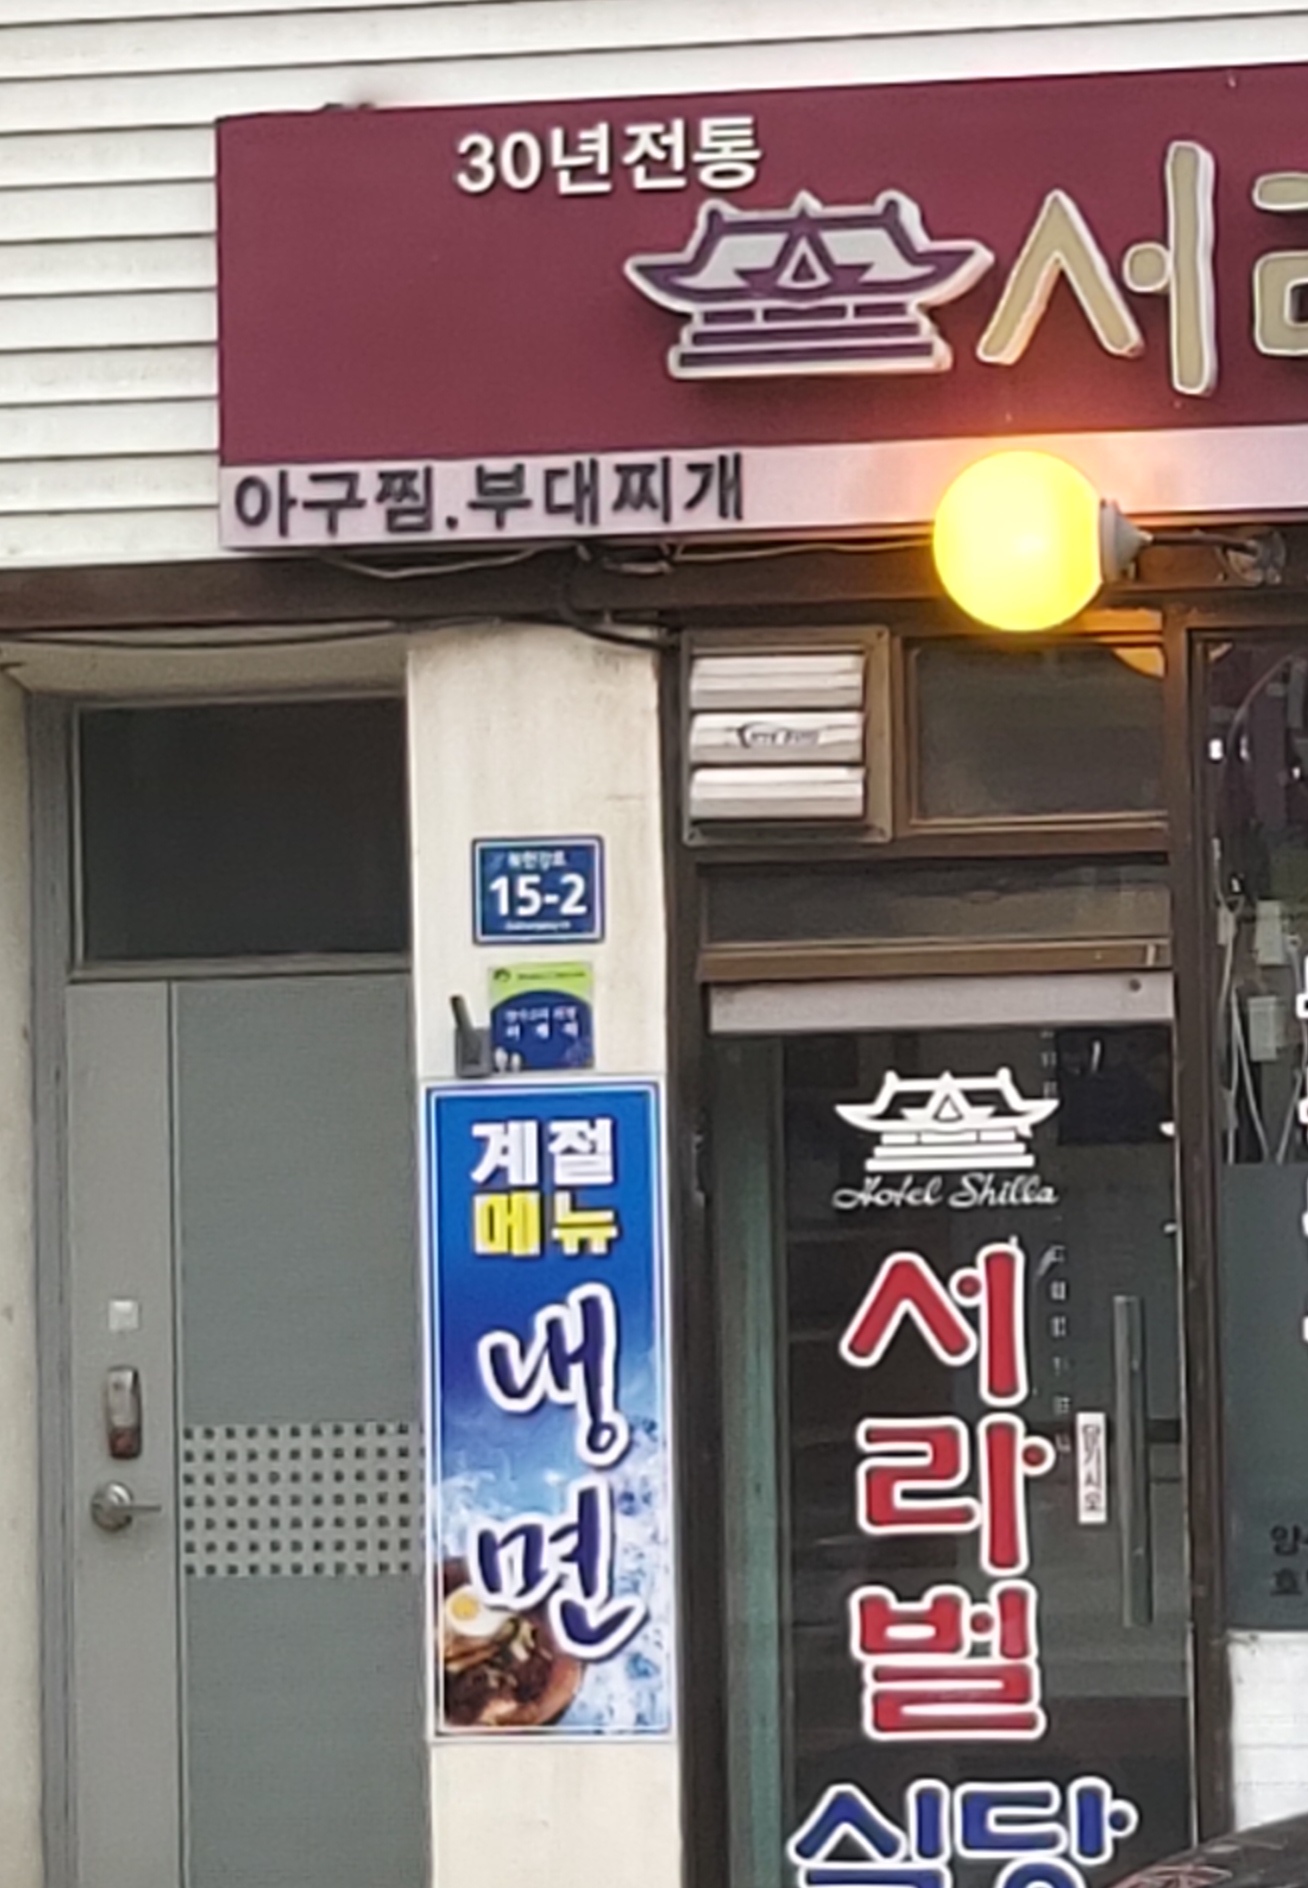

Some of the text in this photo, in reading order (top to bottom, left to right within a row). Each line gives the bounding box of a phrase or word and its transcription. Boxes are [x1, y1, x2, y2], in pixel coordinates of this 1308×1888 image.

[455, 114, 762, 196] 30년전통
[489, 873, 588, 917] 15-2
[470, 1116, 615, 1186] 계절
[472, 1188, 619, 1257] 메뉴
[832, 1172, 1060, 1209] Hotel Shilla
[470, 1282, 647, 1662] 냉면
[839, 1242, 1057, 1741] 서라벌
